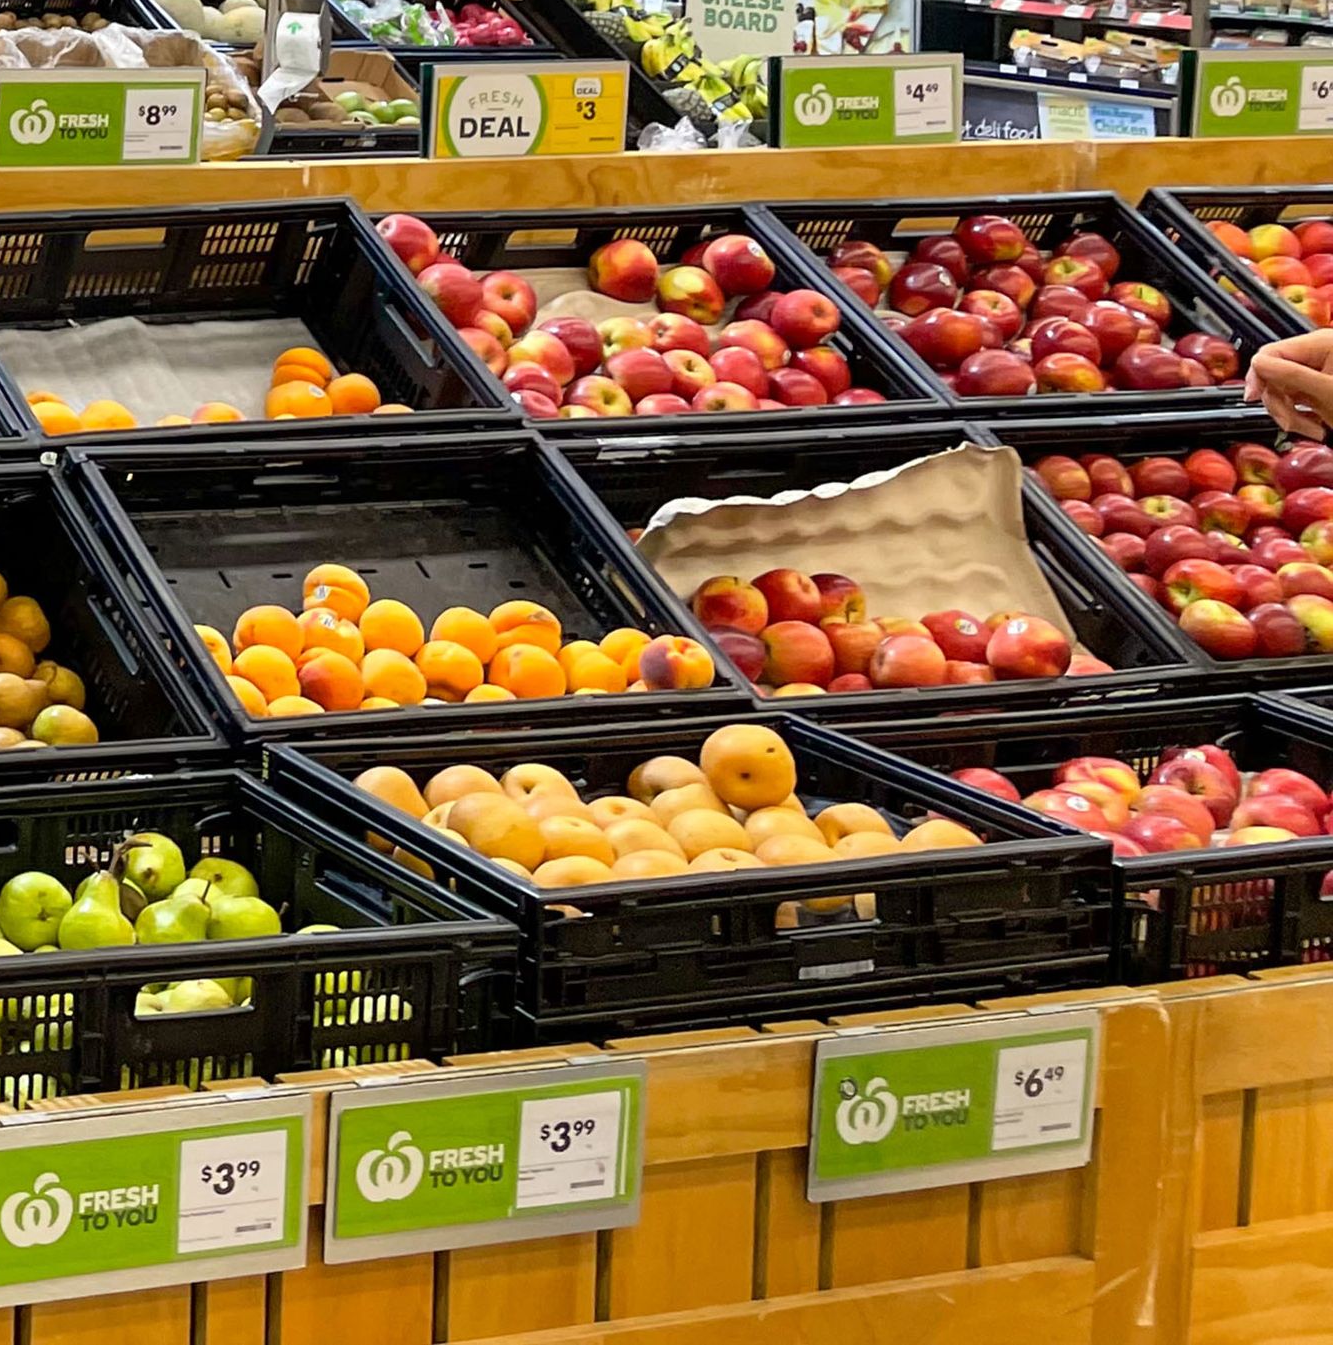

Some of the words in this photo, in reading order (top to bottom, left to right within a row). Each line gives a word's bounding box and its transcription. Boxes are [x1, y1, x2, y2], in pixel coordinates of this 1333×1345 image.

[704, 7, 778, 34] BOARD
[468, 89, 525, 110] FRESH
[575, 101, 597, 121] $3
[835, 96, 880, 110] FRESH
[59, 113, 109, 128] FRESH
[459, 116, 531, 139] DEAL
[974, 119, 1001, 138] deli
[1002, 120, 1038, 140] food
[1093, 118, 1148, 136] Chicken
[59, 127, 78, 140] TO
[81, 127, 109, 140] YOU
[902, 1087, 971, 1116] FRESH
[902, 1113, 929, 1132] TO
[931, 1108, 970, 1127] YOU
[428, 1142, 506, 1172] FRESH
[428, 1169, 459, 1189] TO
[461, 1164, 504, 1185] YOU
[78, 1183, 160, 1215] FRESH
[78, 1209, 110, 1233] TO
[114, 1205, 158, 1229] YOU
